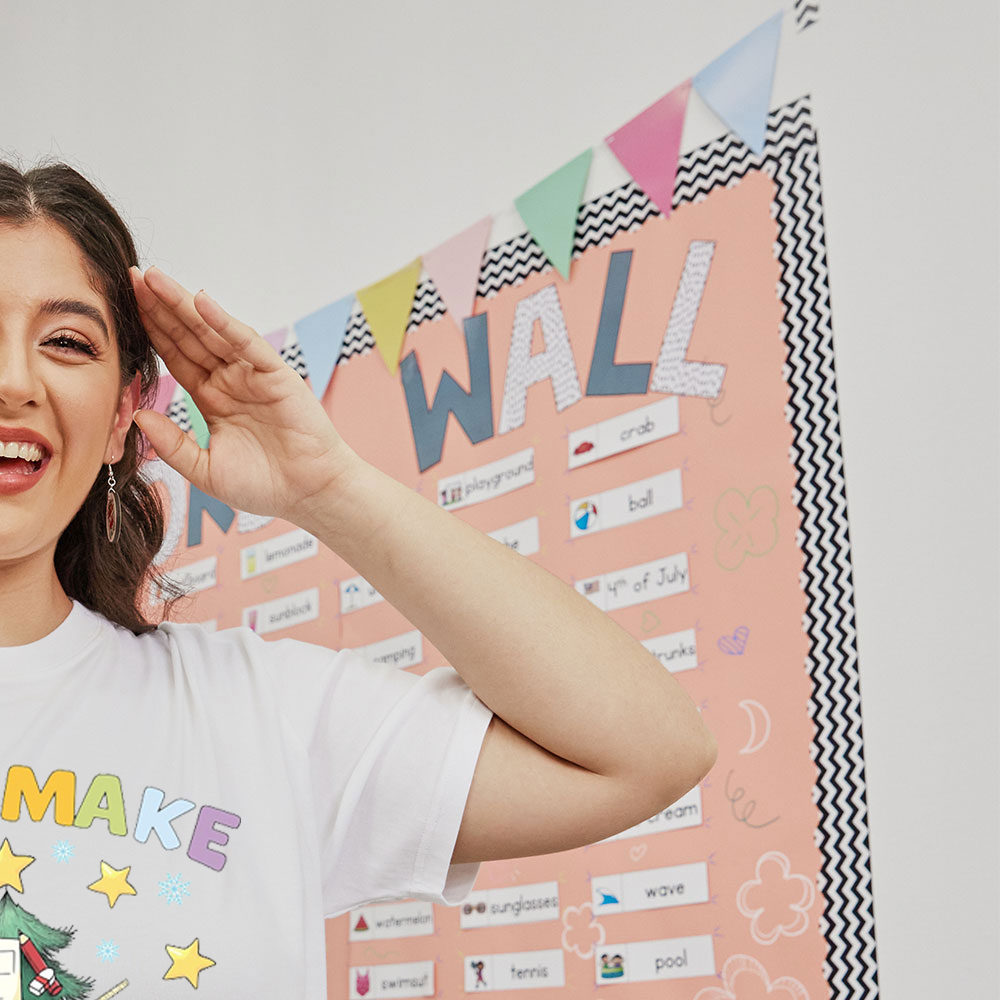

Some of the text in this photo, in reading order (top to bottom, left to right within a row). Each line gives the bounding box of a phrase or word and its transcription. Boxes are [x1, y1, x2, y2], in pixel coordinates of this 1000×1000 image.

[400, 241, 728, 474] WALL
[619, 415, 655, 442] crab
[464, 455, 534, 495] playground
[628, 489, 655, 512] ball
[265, 537, 314, 563] lemonade
[633, 572, 651, 592] of
[656, 565, 688, 587] July
[269, 602, 313, 624] sunblock
[0, 764, 242, 872] MAKE
[645, 882, 685, 898] wave
[489, 894, 559, 917] sunglasses
[376, 913, 433, 929] watermelon
[510, 963, 550, 981] tennis
[655, 948, 688, 975] pool
